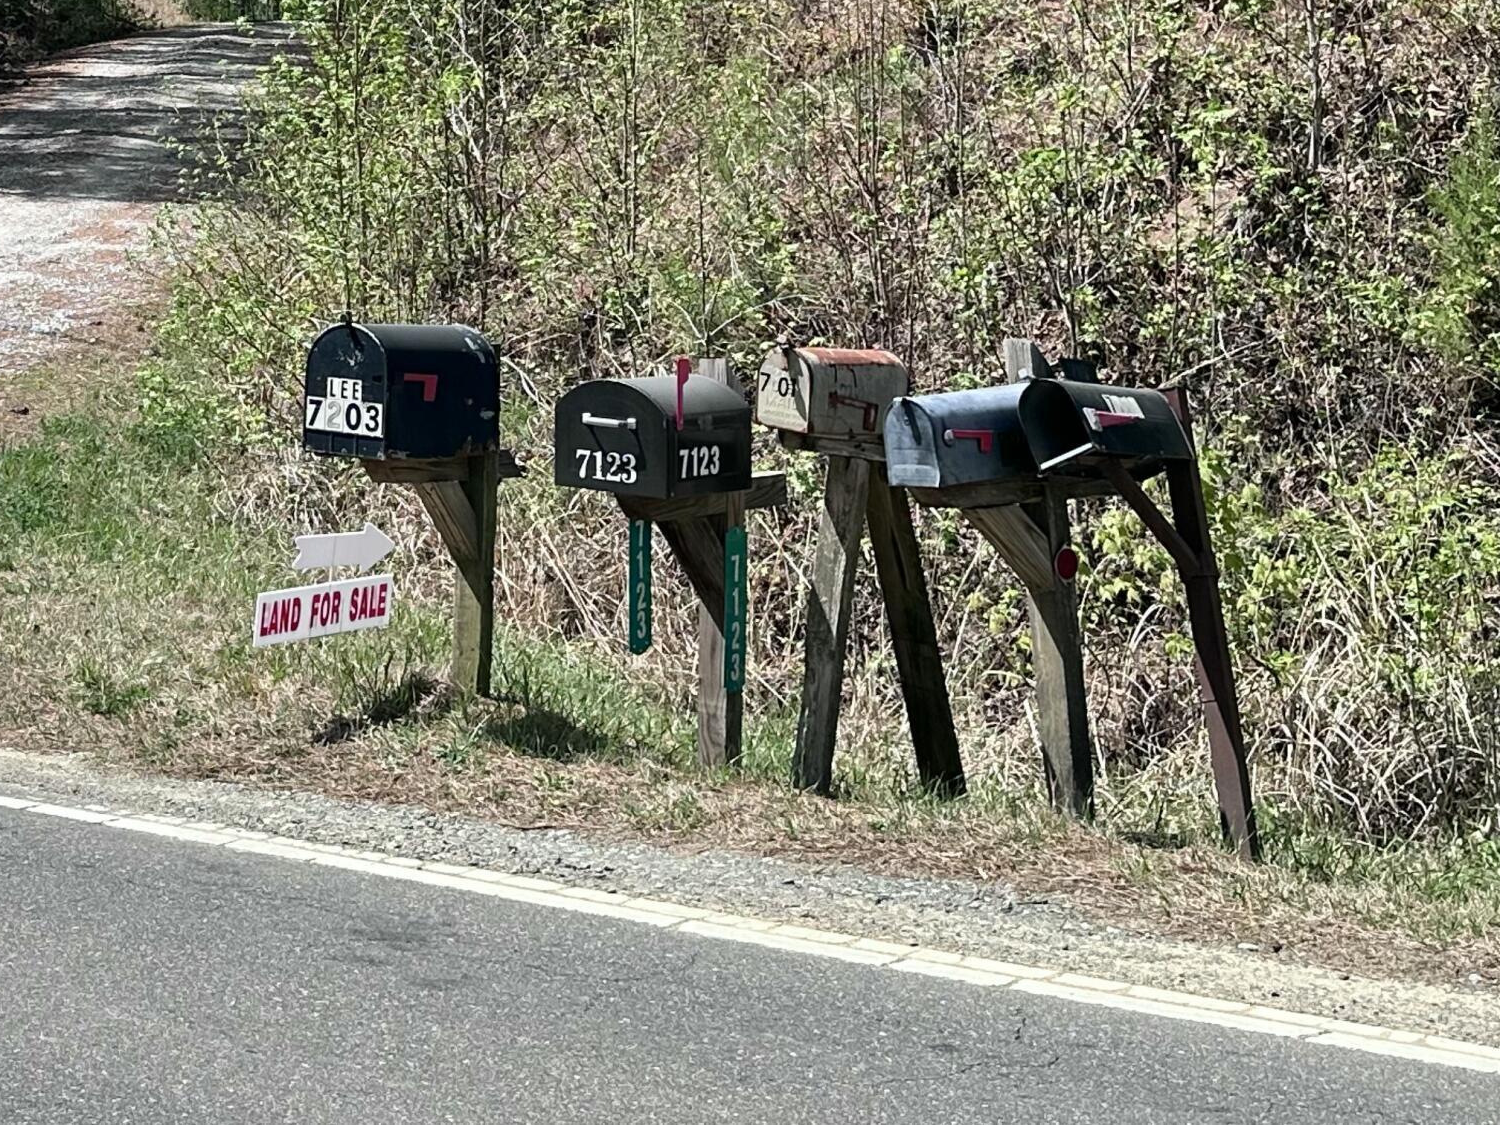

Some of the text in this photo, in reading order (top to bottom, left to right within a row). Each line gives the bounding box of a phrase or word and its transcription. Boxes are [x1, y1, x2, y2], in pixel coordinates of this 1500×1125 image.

[329, 379, 360, 401] LEE
[308, 398, 380, 433] 7203
[575, 448, 638, 484] 7123
[679, 445, 720, 479] 7123
[635, 520, 647, 639] 7123
[259, 583, 388, 637] LAND FOR SALE
[730, 554, 741, 682] 7123
